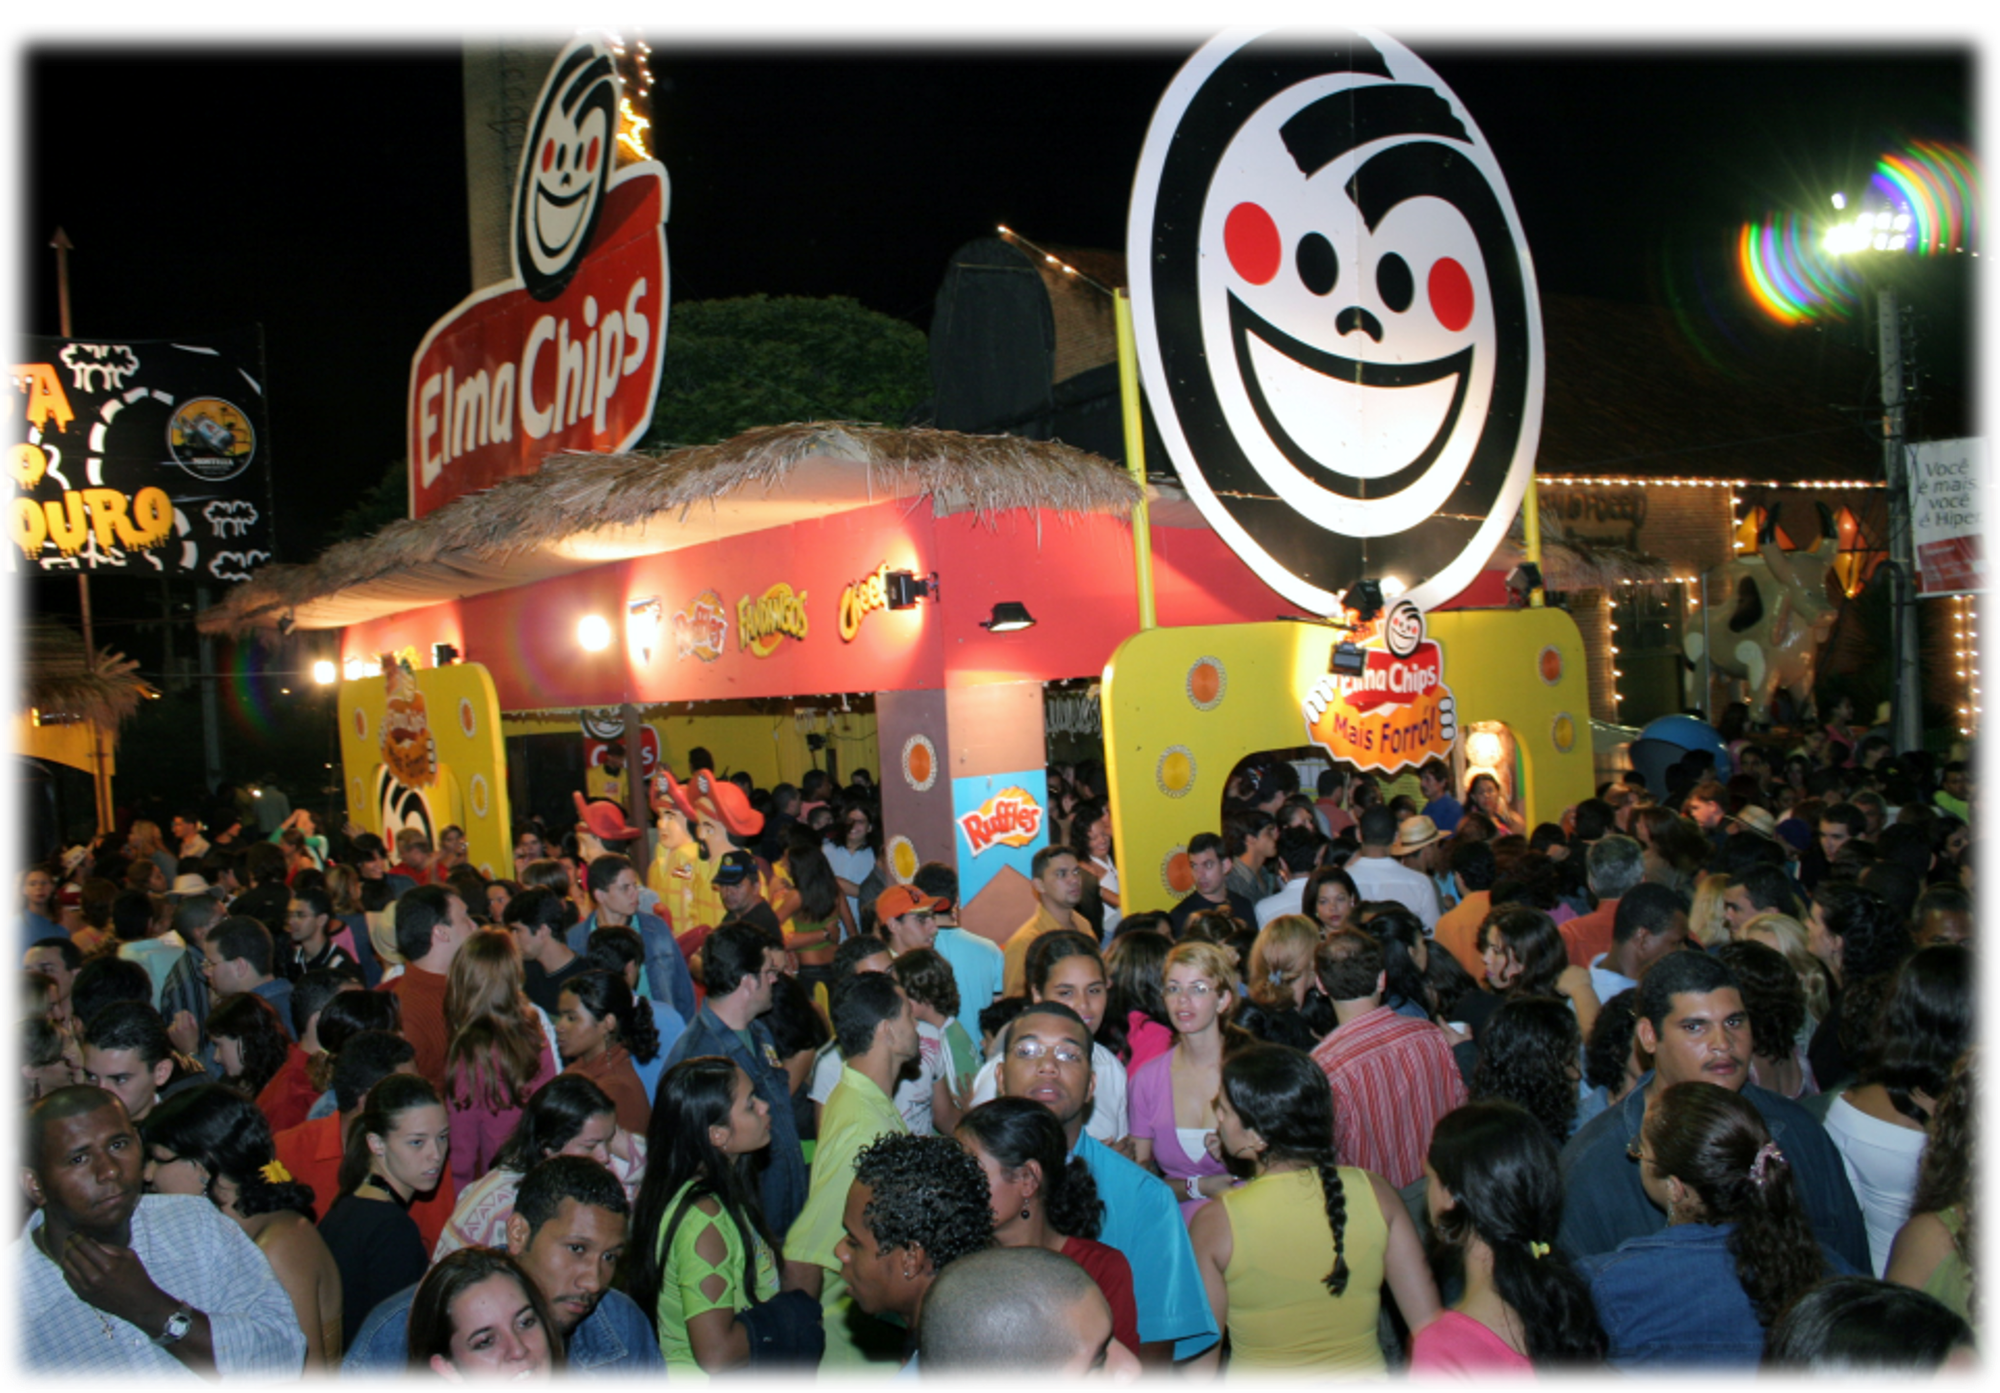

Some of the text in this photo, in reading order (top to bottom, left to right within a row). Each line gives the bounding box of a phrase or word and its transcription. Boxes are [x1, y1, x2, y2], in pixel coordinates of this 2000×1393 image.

[420, 277, 650, 489] Elma Chips
[1925, 458, 1970, 477] Você
[1929, 493, 1971, 510] você
[1935, 510, 1985, 530] Hiper.
[736, 589, 808, 652] FANDANGOS
[1389, 662, 1437, 695] Chips
[1332, 712, 1374, 752] Mais
[962, 799, 1041, 851] Ruffles
